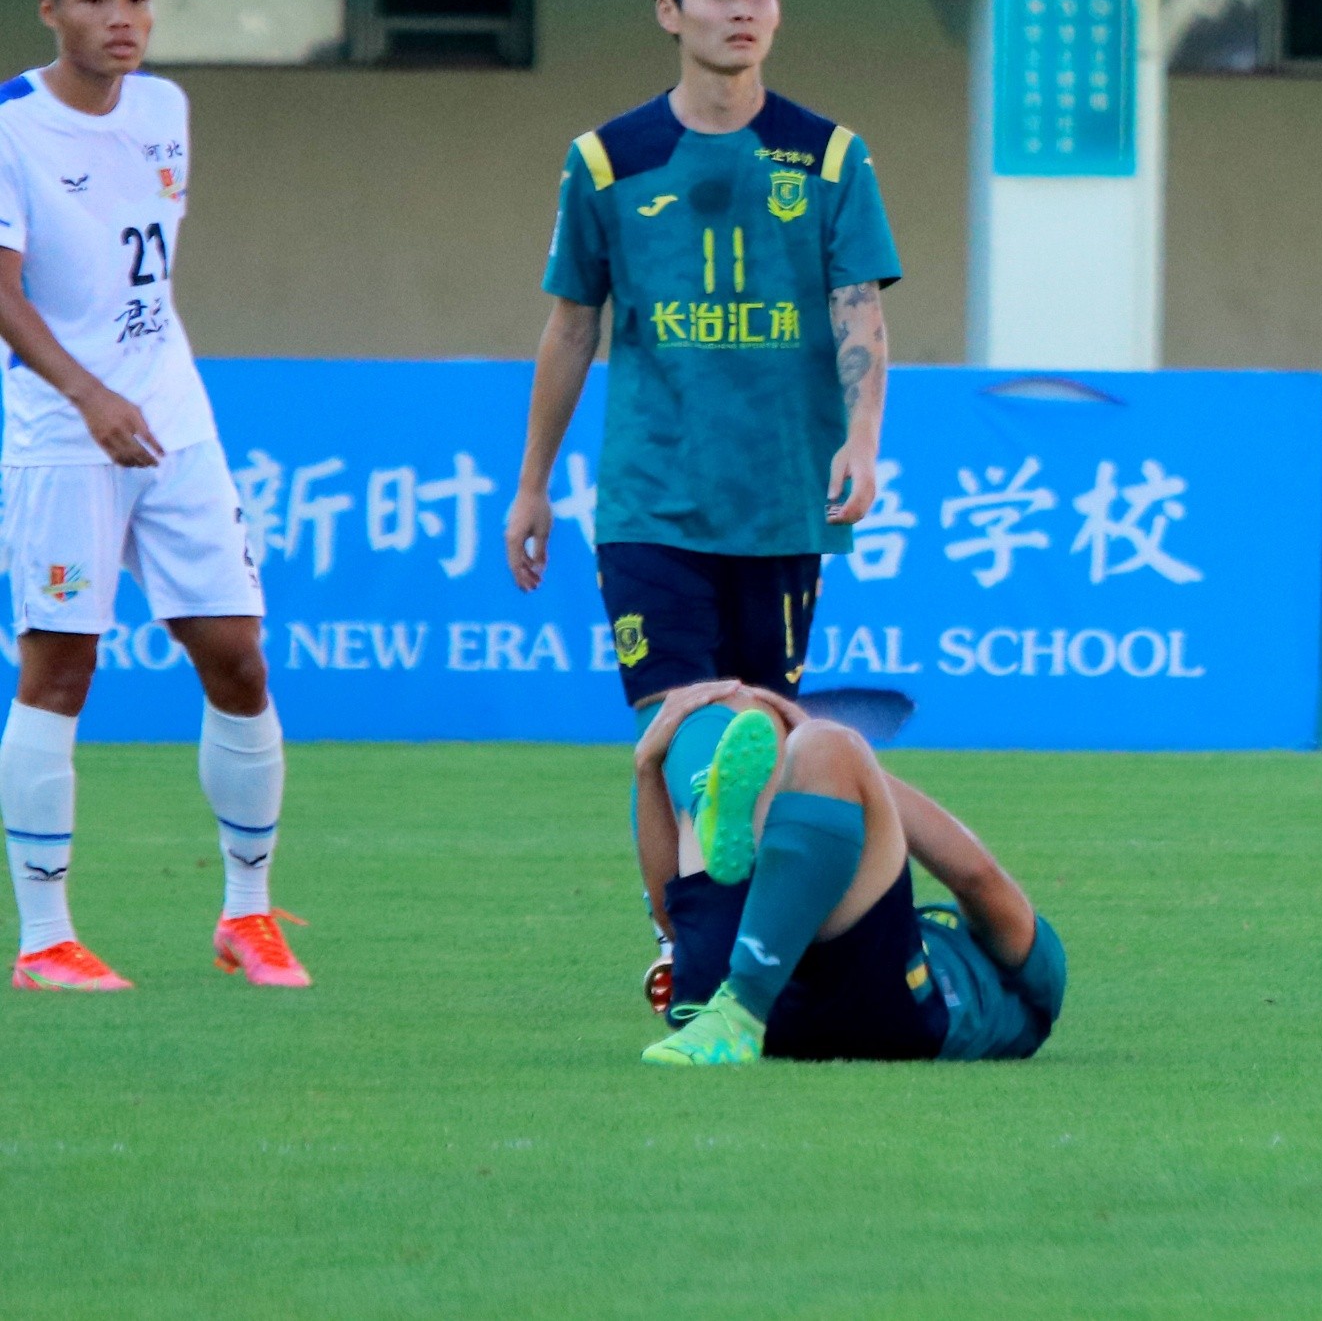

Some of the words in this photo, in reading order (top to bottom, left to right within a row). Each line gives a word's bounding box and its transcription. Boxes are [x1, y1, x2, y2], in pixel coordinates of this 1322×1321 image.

[120, 222, 168, 287] 21
[703, 227, 746, 294] 11
[650, 300, 800, 343] 长治汇承
[285, 621, 427, 671] NEW
[447, 622, 571, 672] ERA
[938, 626, 1207, 678] SCHOOL
